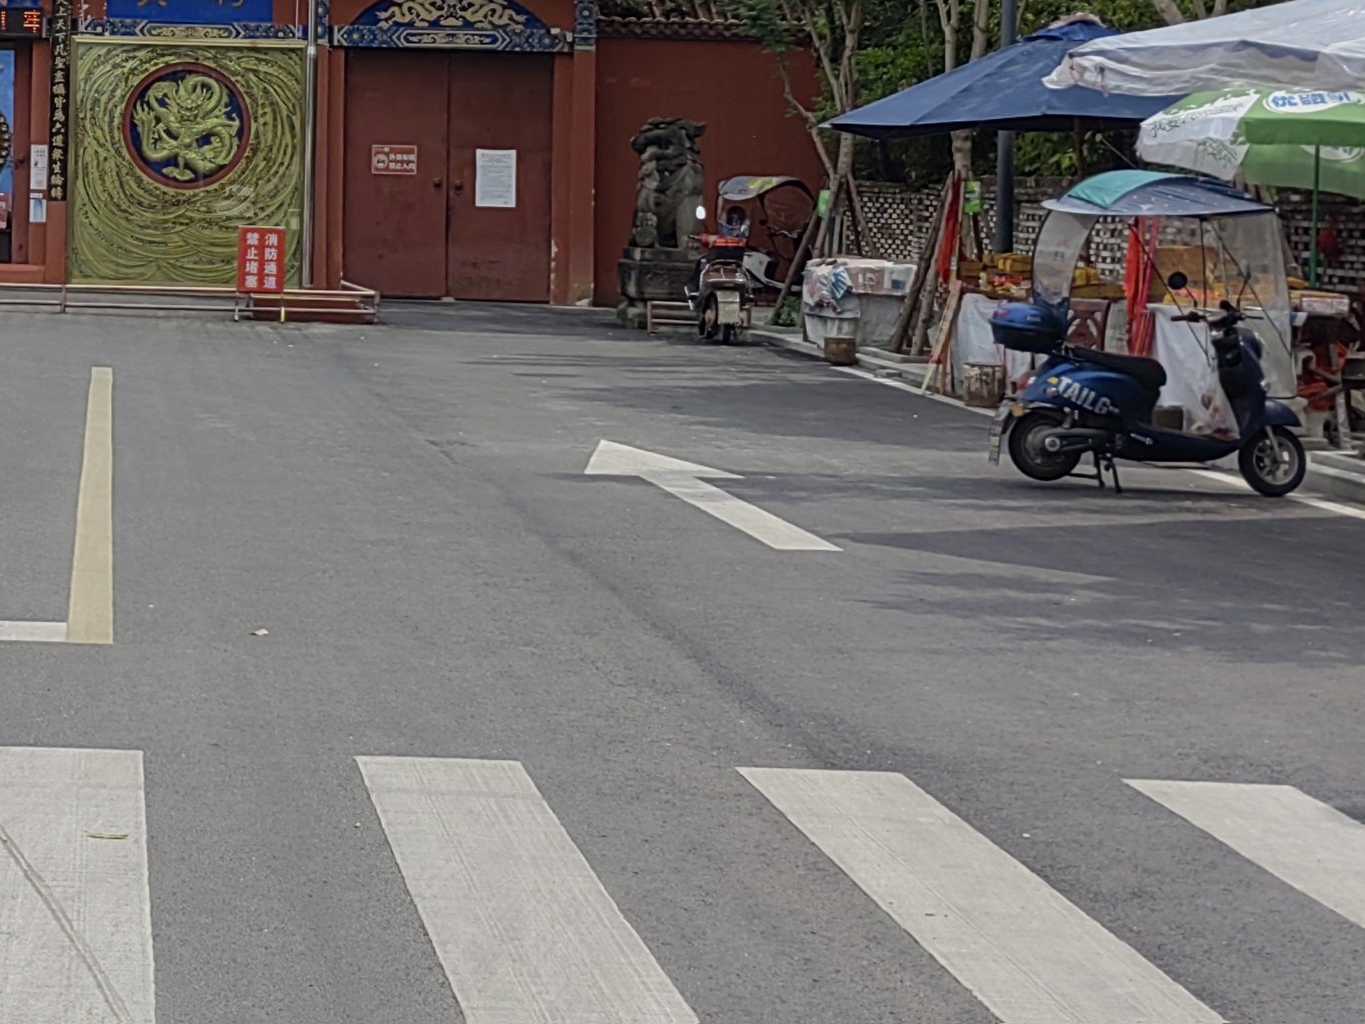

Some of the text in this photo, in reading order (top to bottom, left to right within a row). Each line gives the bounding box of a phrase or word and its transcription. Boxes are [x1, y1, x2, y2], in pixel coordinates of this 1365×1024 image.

[264, 232, 278, 289] 消防通道
[1058, 376, 1111, 414] TAILG
